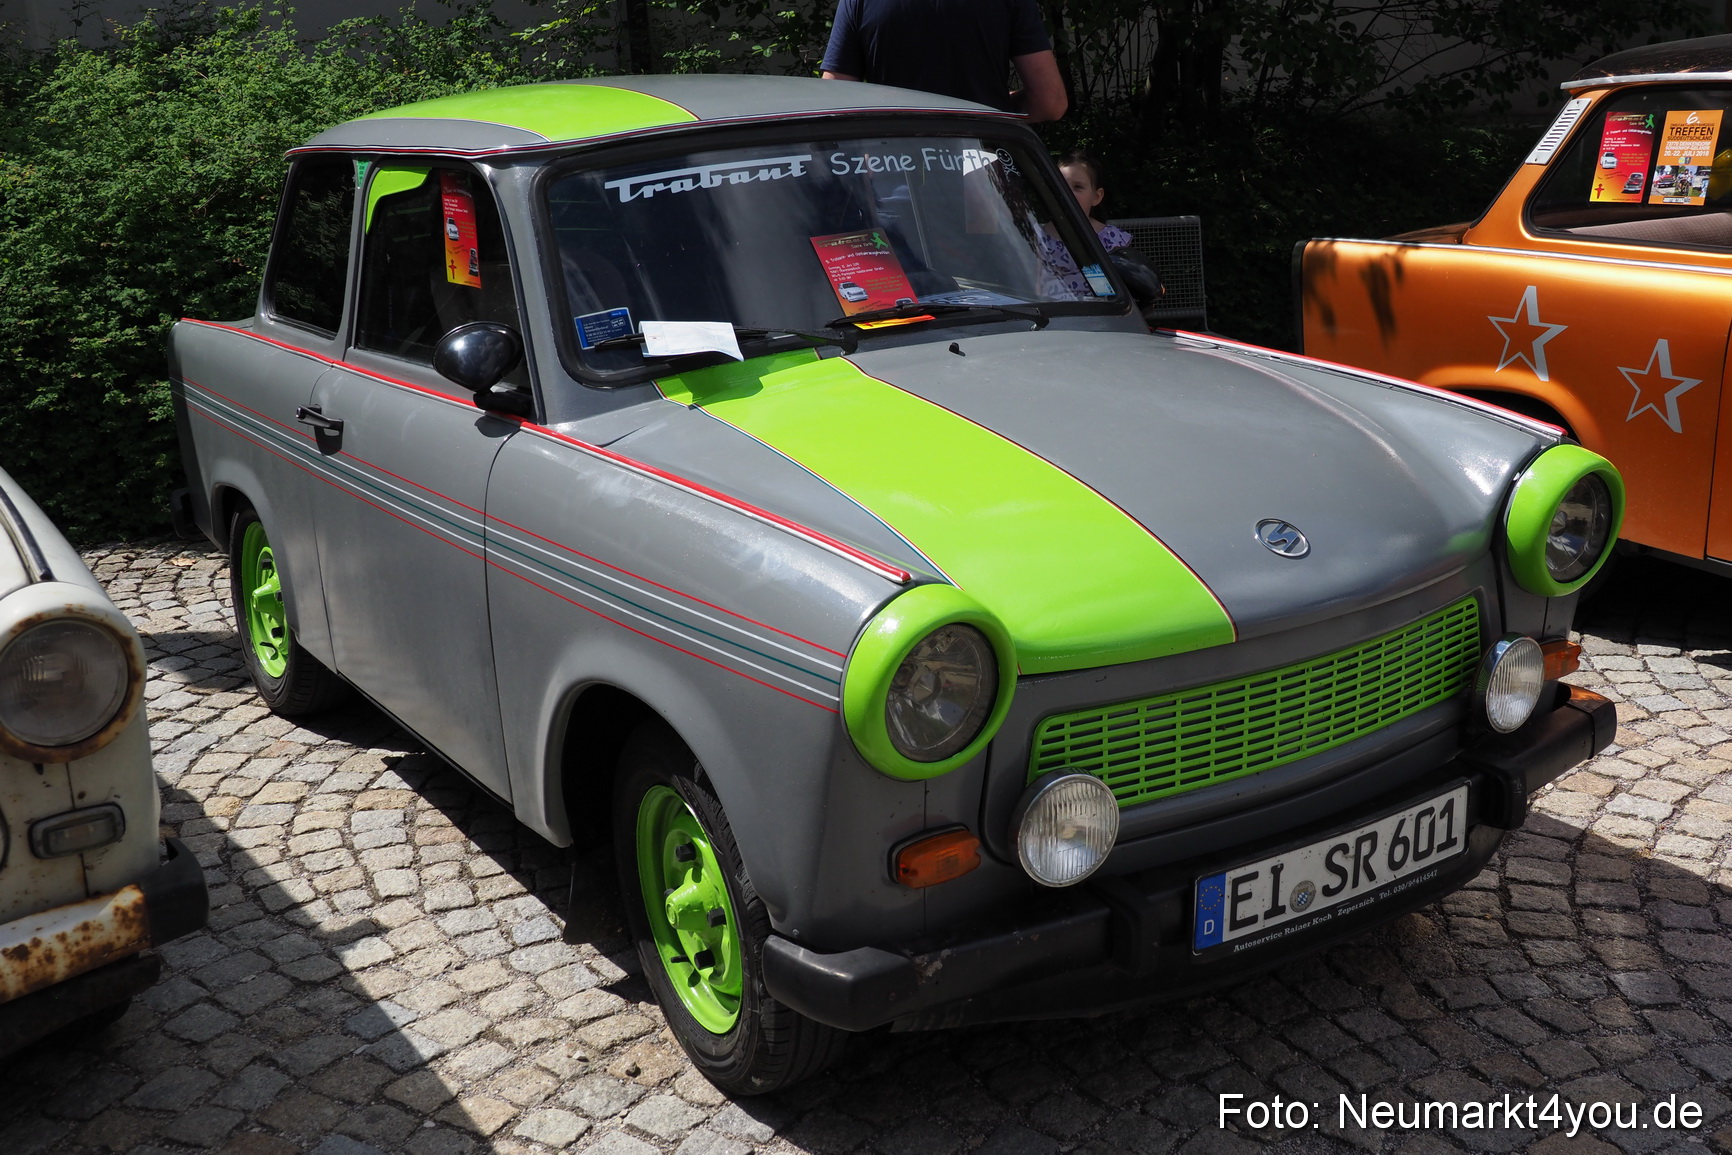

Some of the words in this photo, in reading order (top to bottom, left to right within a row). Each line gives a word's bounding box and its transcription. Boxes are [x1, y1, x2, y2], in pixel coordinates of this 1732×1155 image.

[1670, 127, 1714, 136] TREFFEN
[604, 154, 812, 204] Trabant
[830, 152, 916, 175] Szene
[921, 147, 993, 172] Fürth
[1203, 919, 1215, 936] D
[1229, 863, 1286, 932] EI
[1321, 830, 1378, 897] SR
[1387, 797, 1458, 872] 601
[1233, 930, 1283, 952] Autoservice
[1284, 919, 1311, 935] Rainer
[1312, 912, 1333, 926] Koch
[1337, 895, 1375, 917] Zepernick
